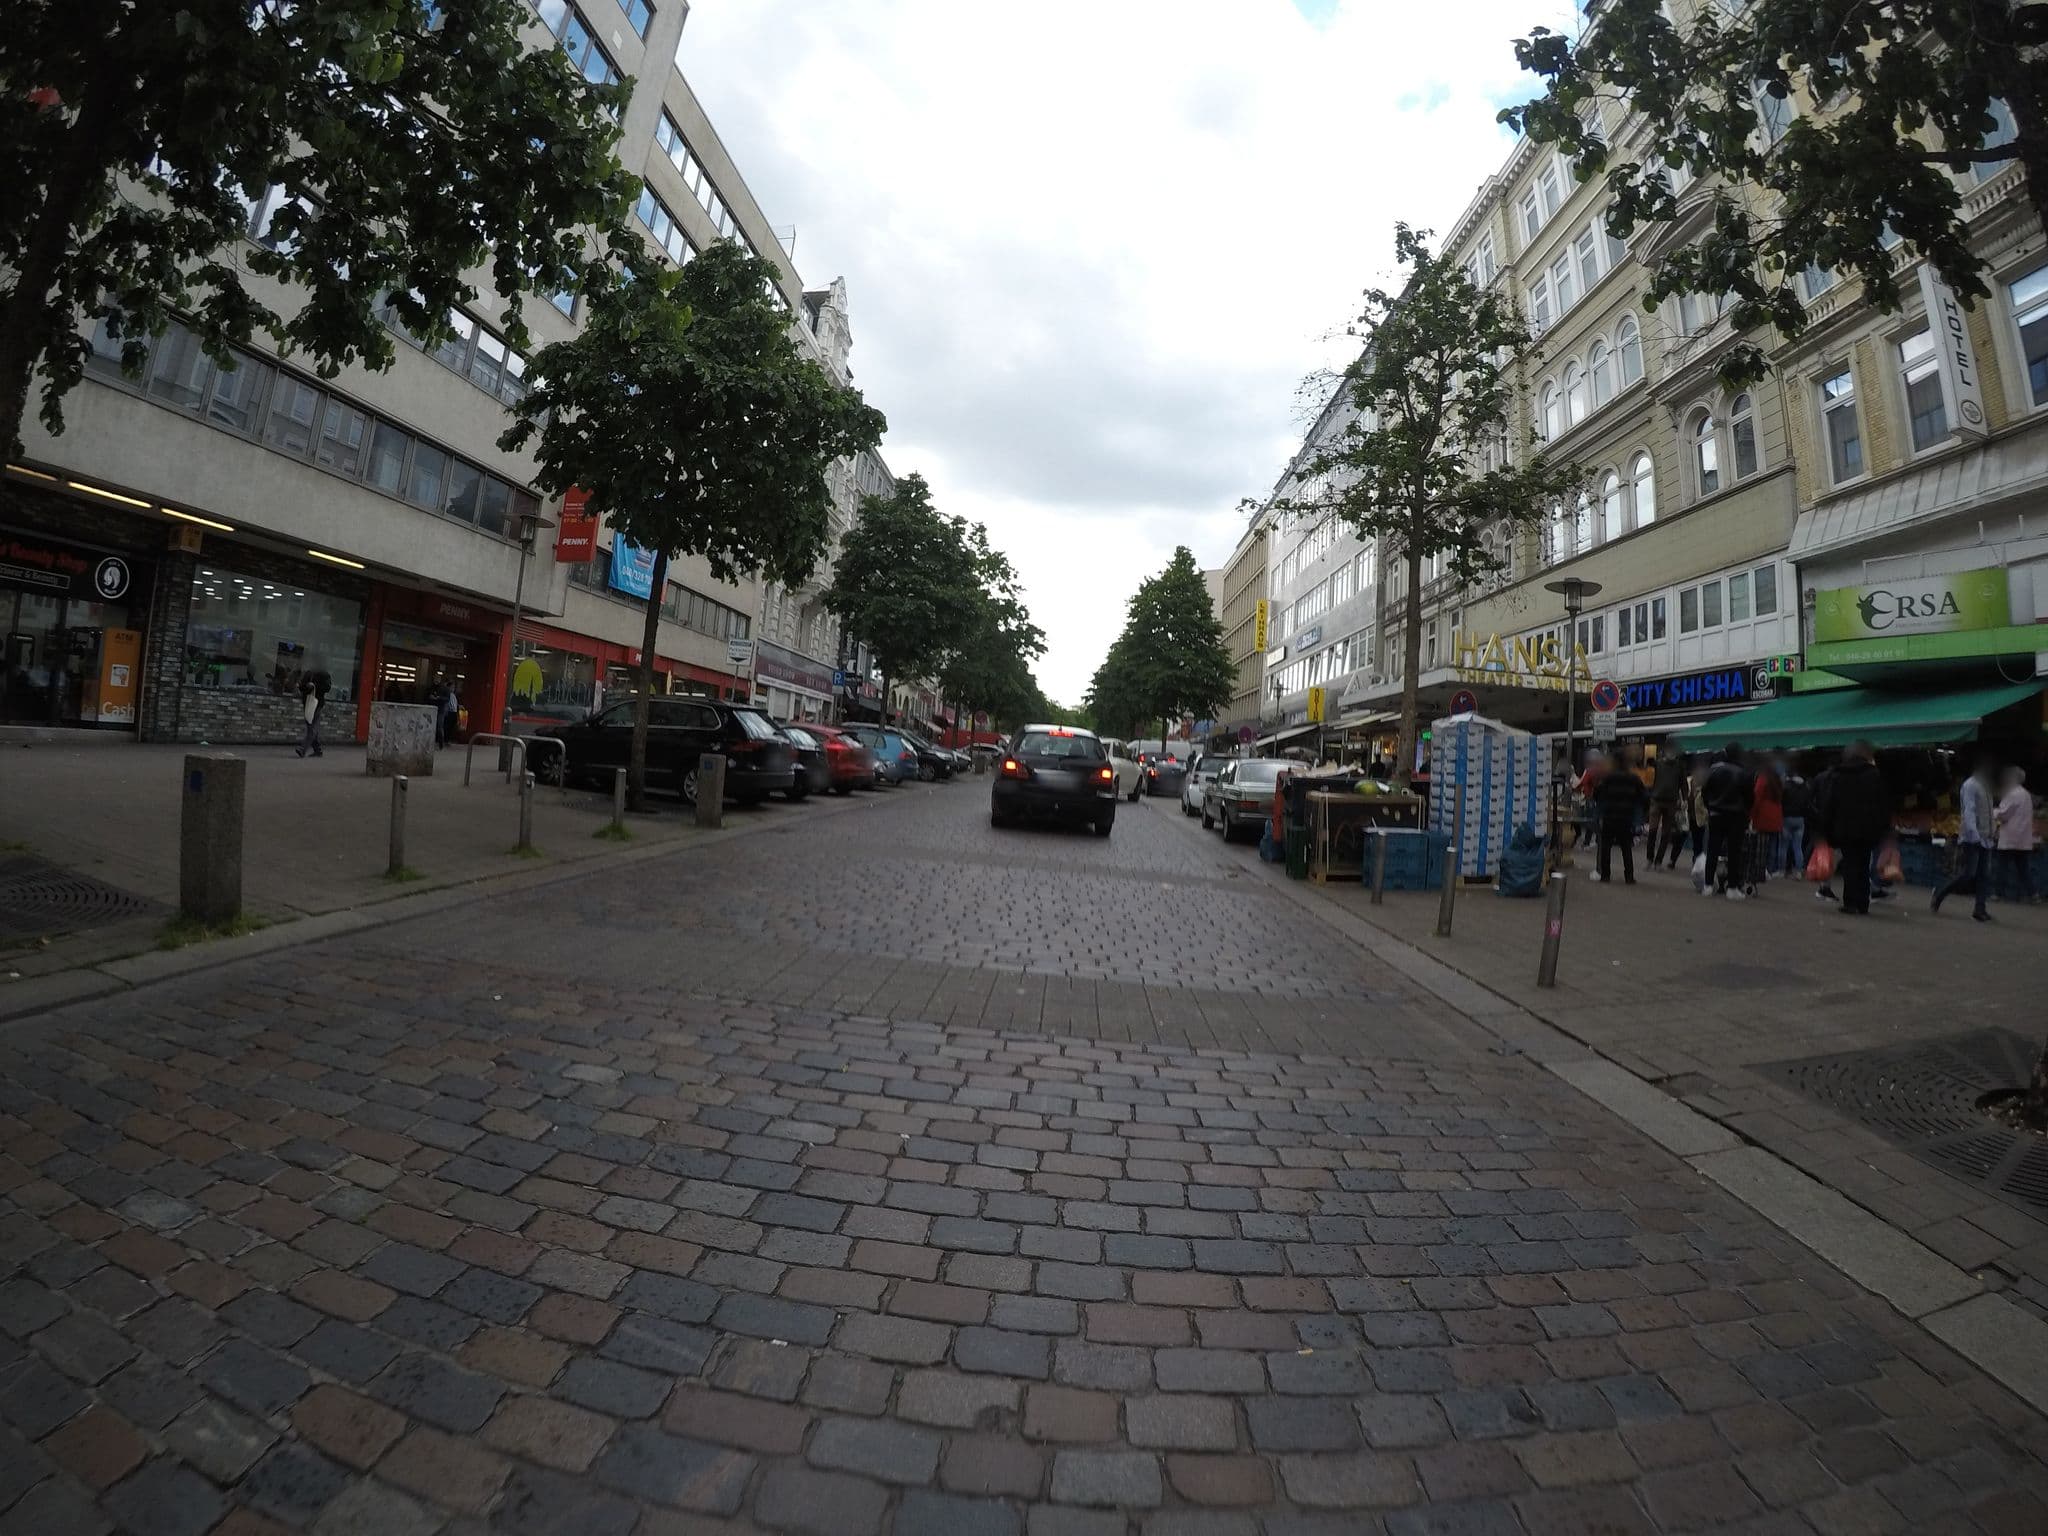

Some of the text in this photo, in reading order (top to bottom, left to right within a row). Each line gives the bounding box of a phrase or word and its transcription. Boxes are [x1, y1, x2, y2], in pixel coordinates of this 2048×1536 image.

[1943, 298, 1971, 387] HOTEL
[1454, 630, 1593, 681] HANSA
[103, 702, 135, 721] Cash
[1627, 671, 1745, 710] CITY SHISHA
